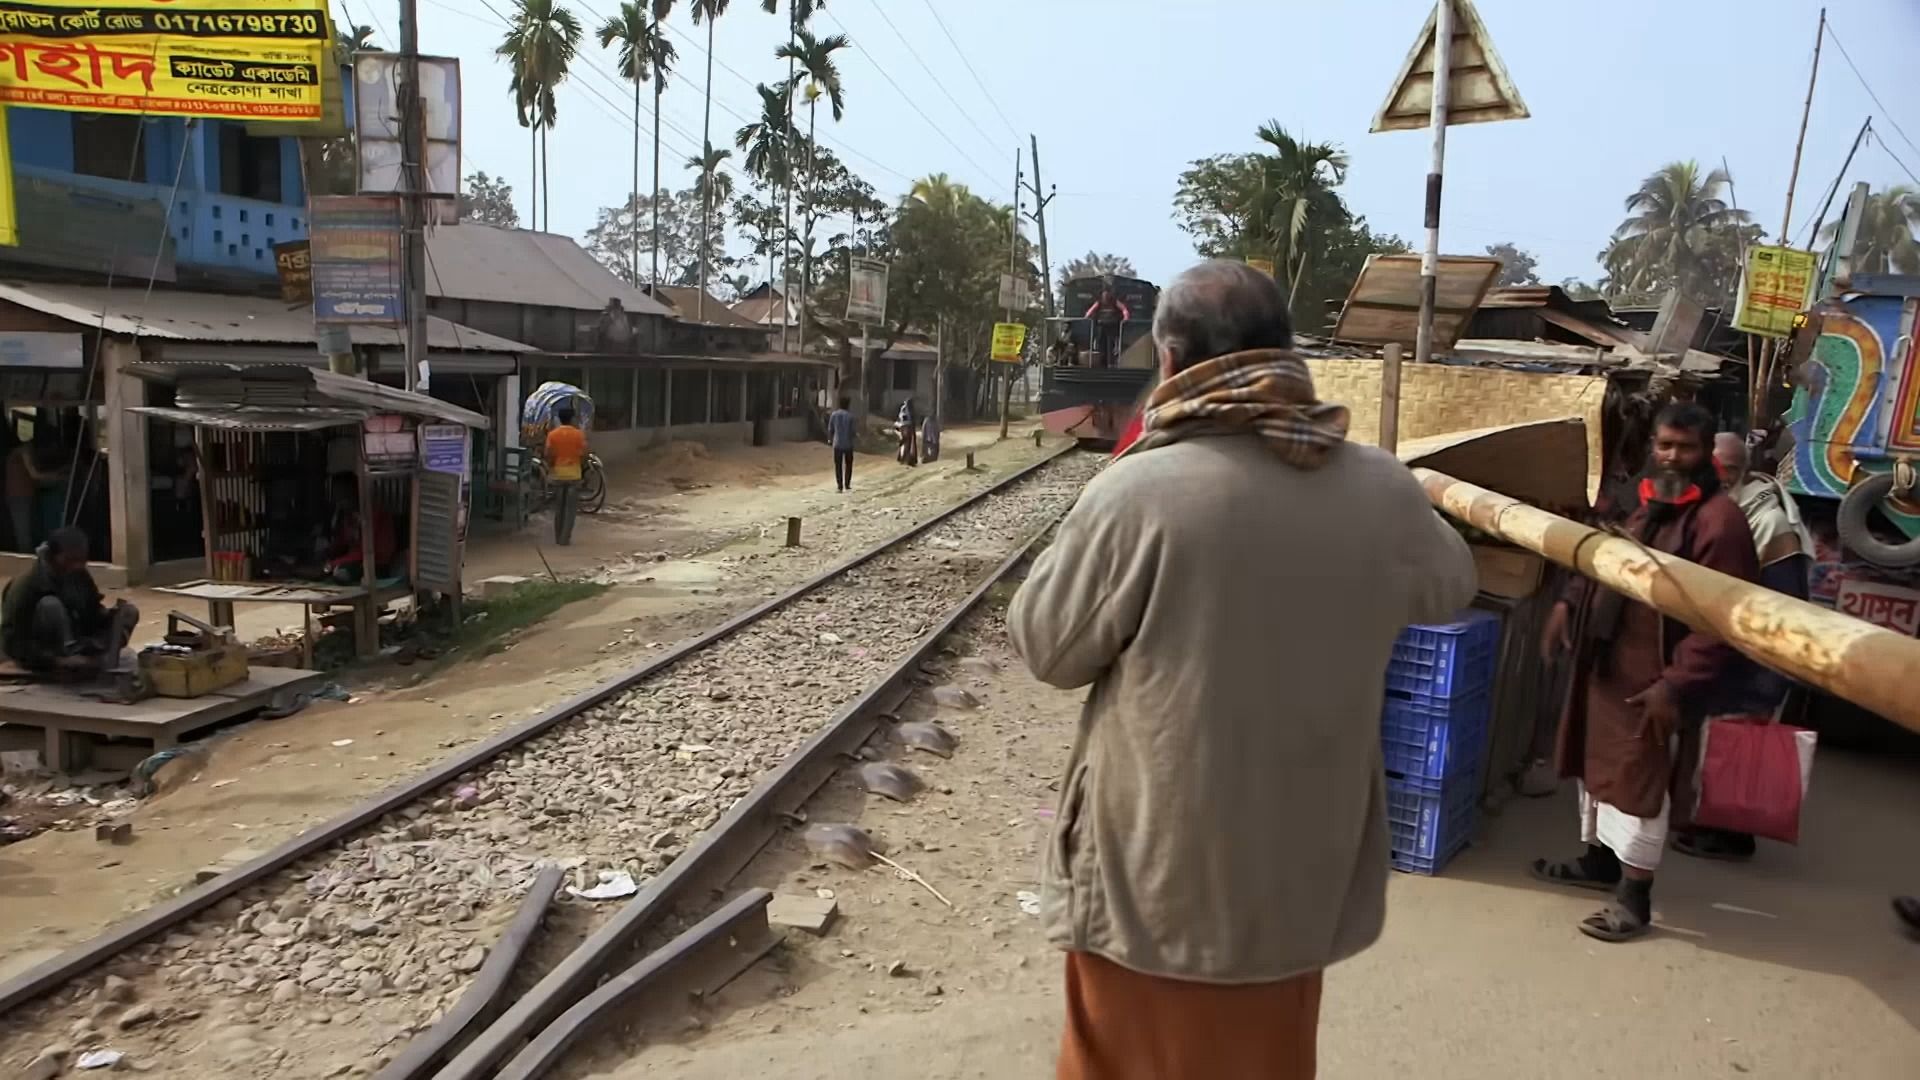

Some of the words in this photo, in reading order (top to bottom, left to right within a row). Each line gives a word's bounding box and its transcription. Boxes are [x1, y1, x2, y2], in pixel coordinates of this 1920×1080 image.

[60, 9, 101, 30] কোর্ট
[105, 14, 144, 29] রোড
[154, 13, 317, 33] 01716798730
[172, 61, 235, 78] ক্যাডেট
[241, 64, 311, 82] একাডেমি
[269, 86, 303, 100] শাখা
[1842, 589, 1919, 629] থামুন
